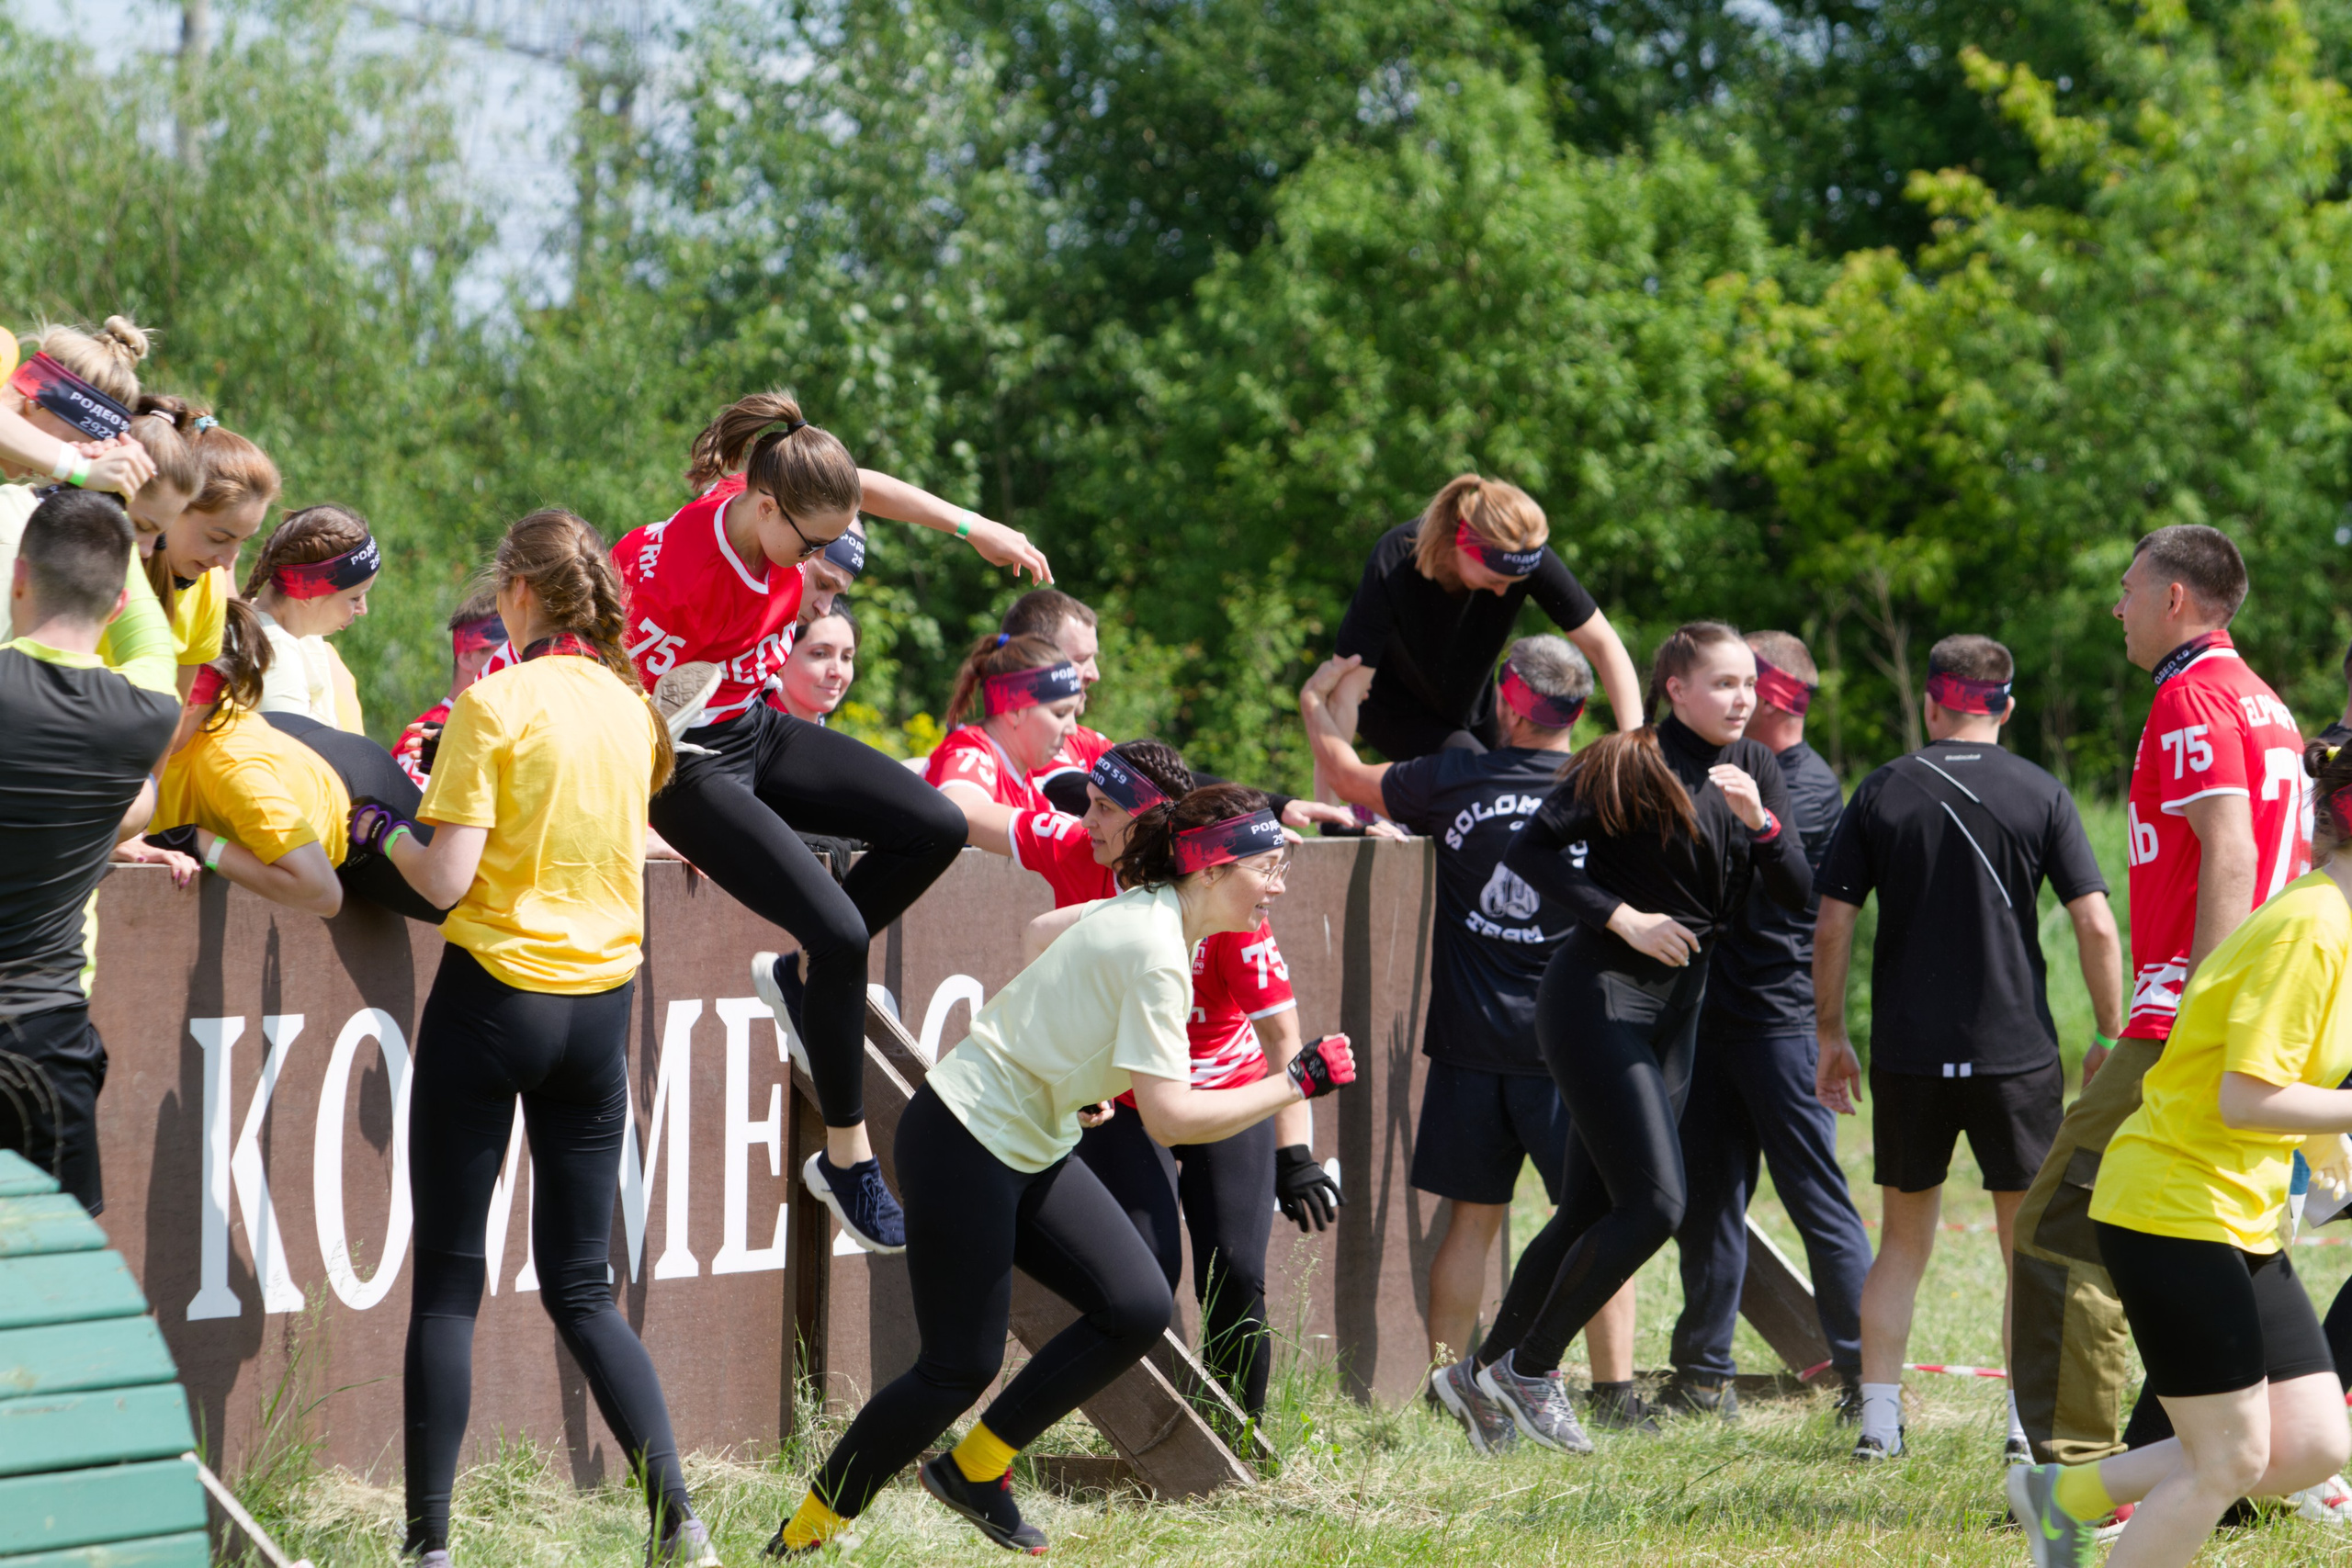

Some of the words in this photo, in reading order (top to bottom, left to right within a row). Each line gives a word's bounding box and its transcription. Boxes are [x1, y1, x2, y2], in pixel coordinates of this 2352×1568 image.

[70, 391, 121, 425] РОДЕО
[627, 616, 687, 676] 75
[1110, 768, 1128, 785] 59
[2160, 724, 2214, 781] 75
[1241, 936, 1290, 990] 75
